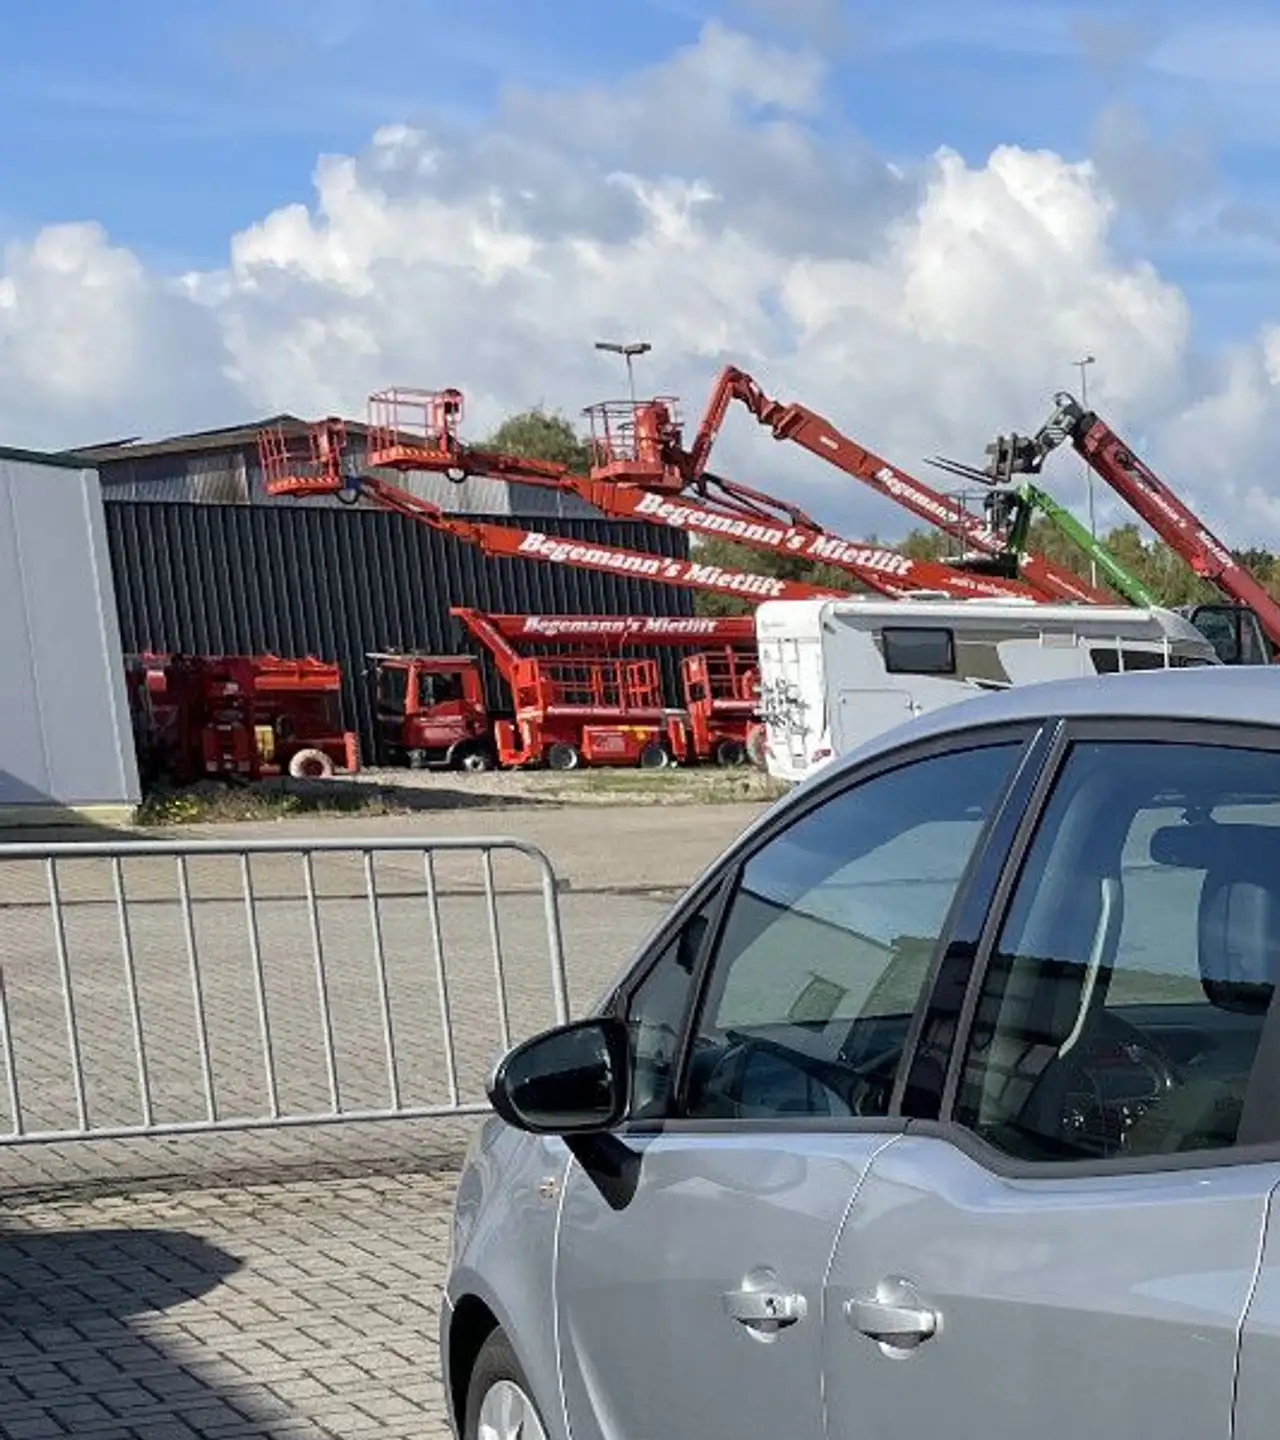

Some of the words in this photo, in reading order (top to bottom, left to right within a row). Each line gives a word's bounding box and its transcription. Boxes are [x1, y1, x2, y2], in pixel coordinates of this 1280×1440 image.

[519, 532, 681, 579] Begemann's
[684, 563, 786, 597] Mietlift
[633, 492, 806, 550] Begemann's
[807, 534, 914, 577] Mietlift
[523, 617, 641, 636] Begemann's
